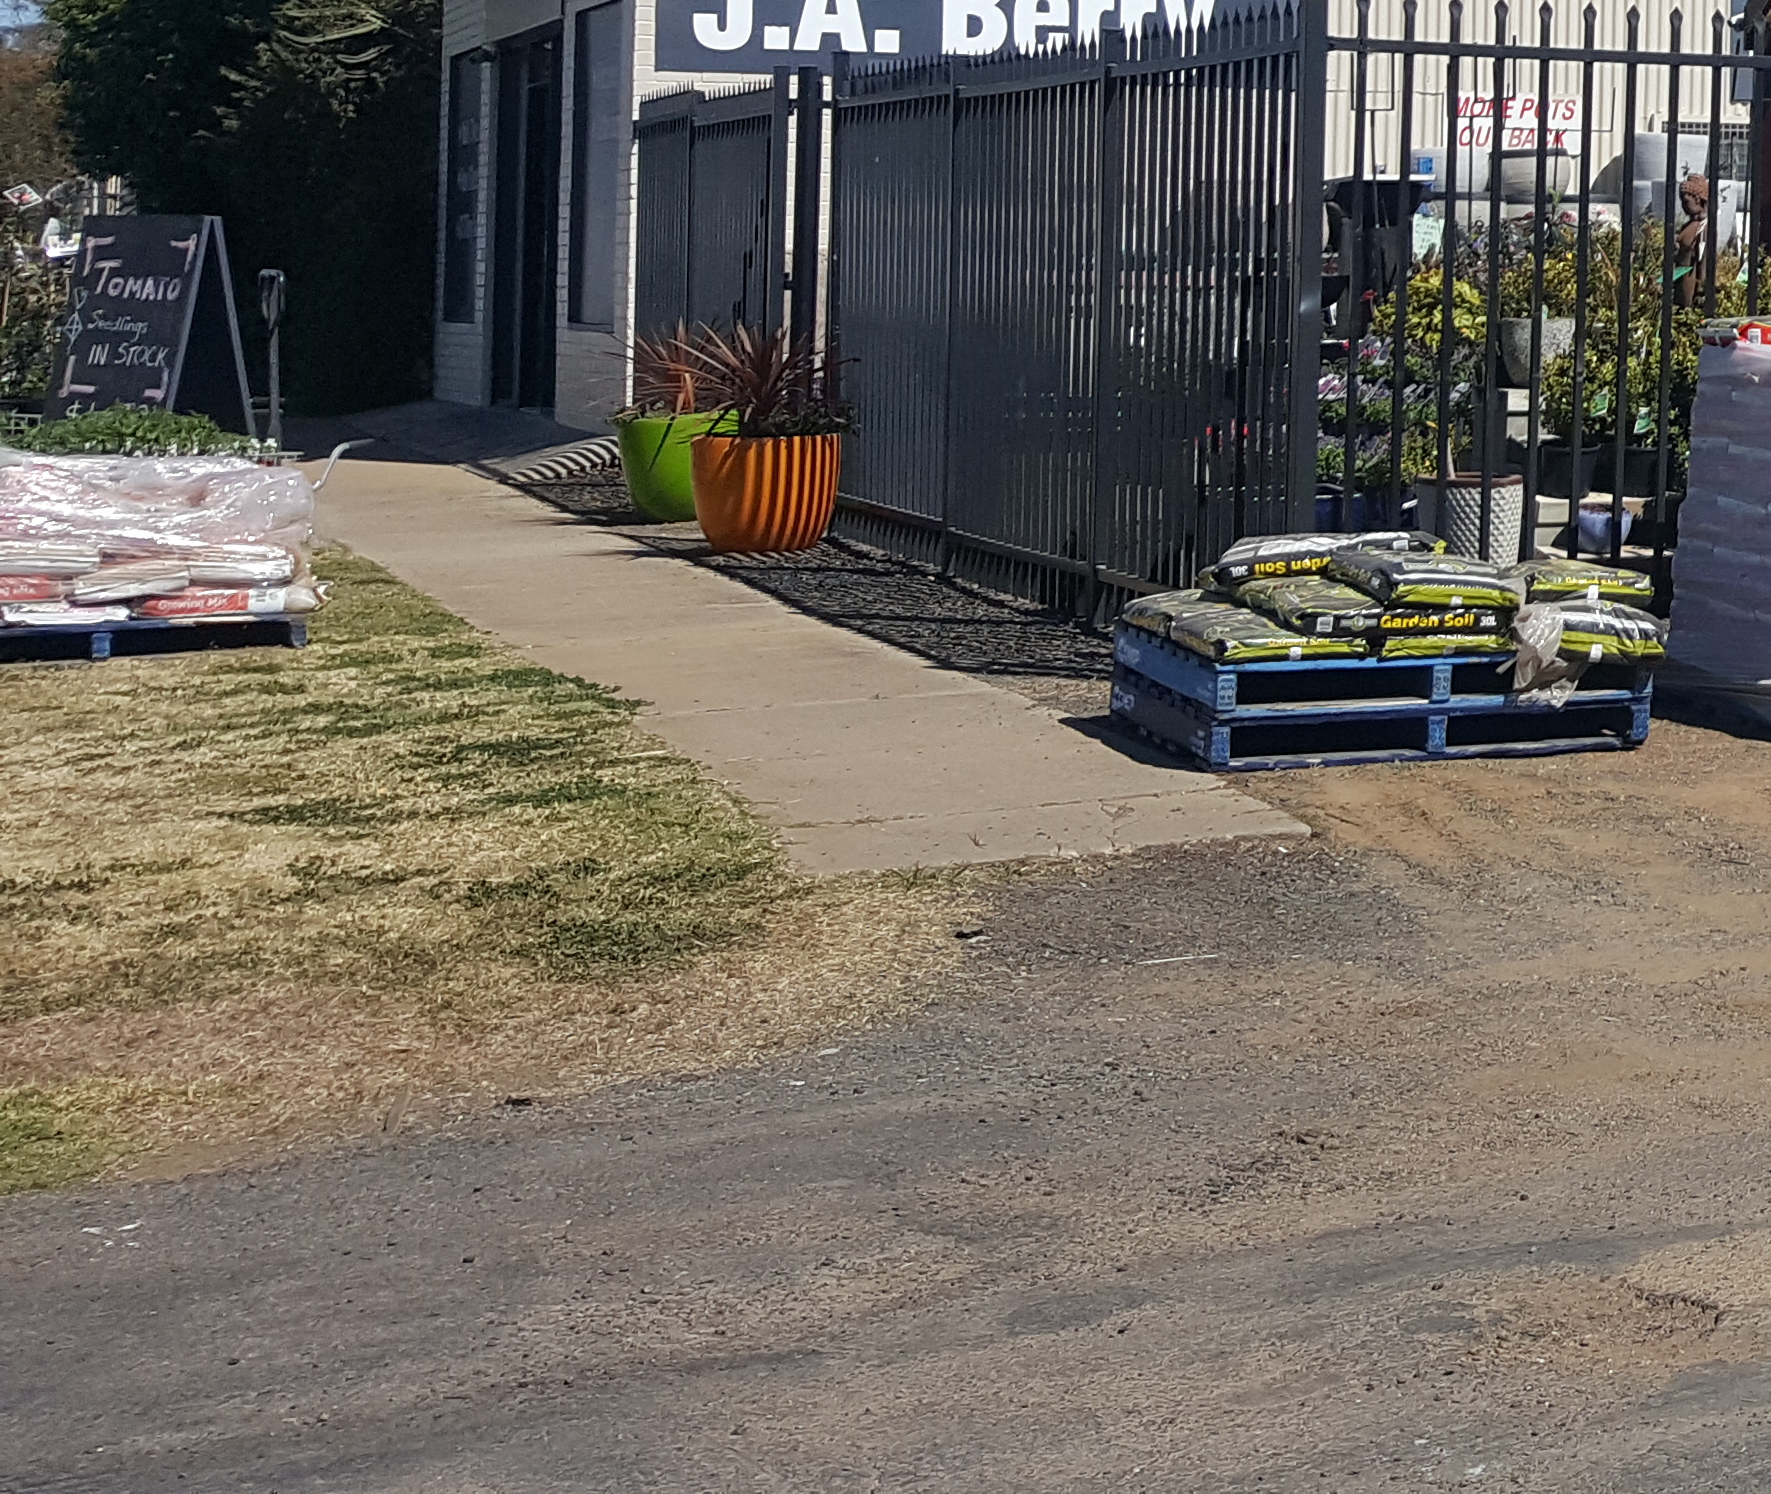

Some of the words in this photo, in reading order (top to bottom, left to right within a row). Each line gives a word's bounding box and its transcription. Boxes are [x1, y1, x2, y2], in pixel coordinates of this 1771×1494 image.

[1459, 125, 1493, 148] OU
[94, 258, 183, 302] TOMATO
[87, 309, 150, 342] Seedlings
[87, 343, 110, 365] IN
[113, 342, 170, 367] STOCK
[1254, 561, 1287, 576] Soil
[1290, 556, 1332, 572] rden
[158, 596, 205, 610] Growing
[1379, 614, 1439, 629] Garden
[1444, 613, 1475, 627] Soil
